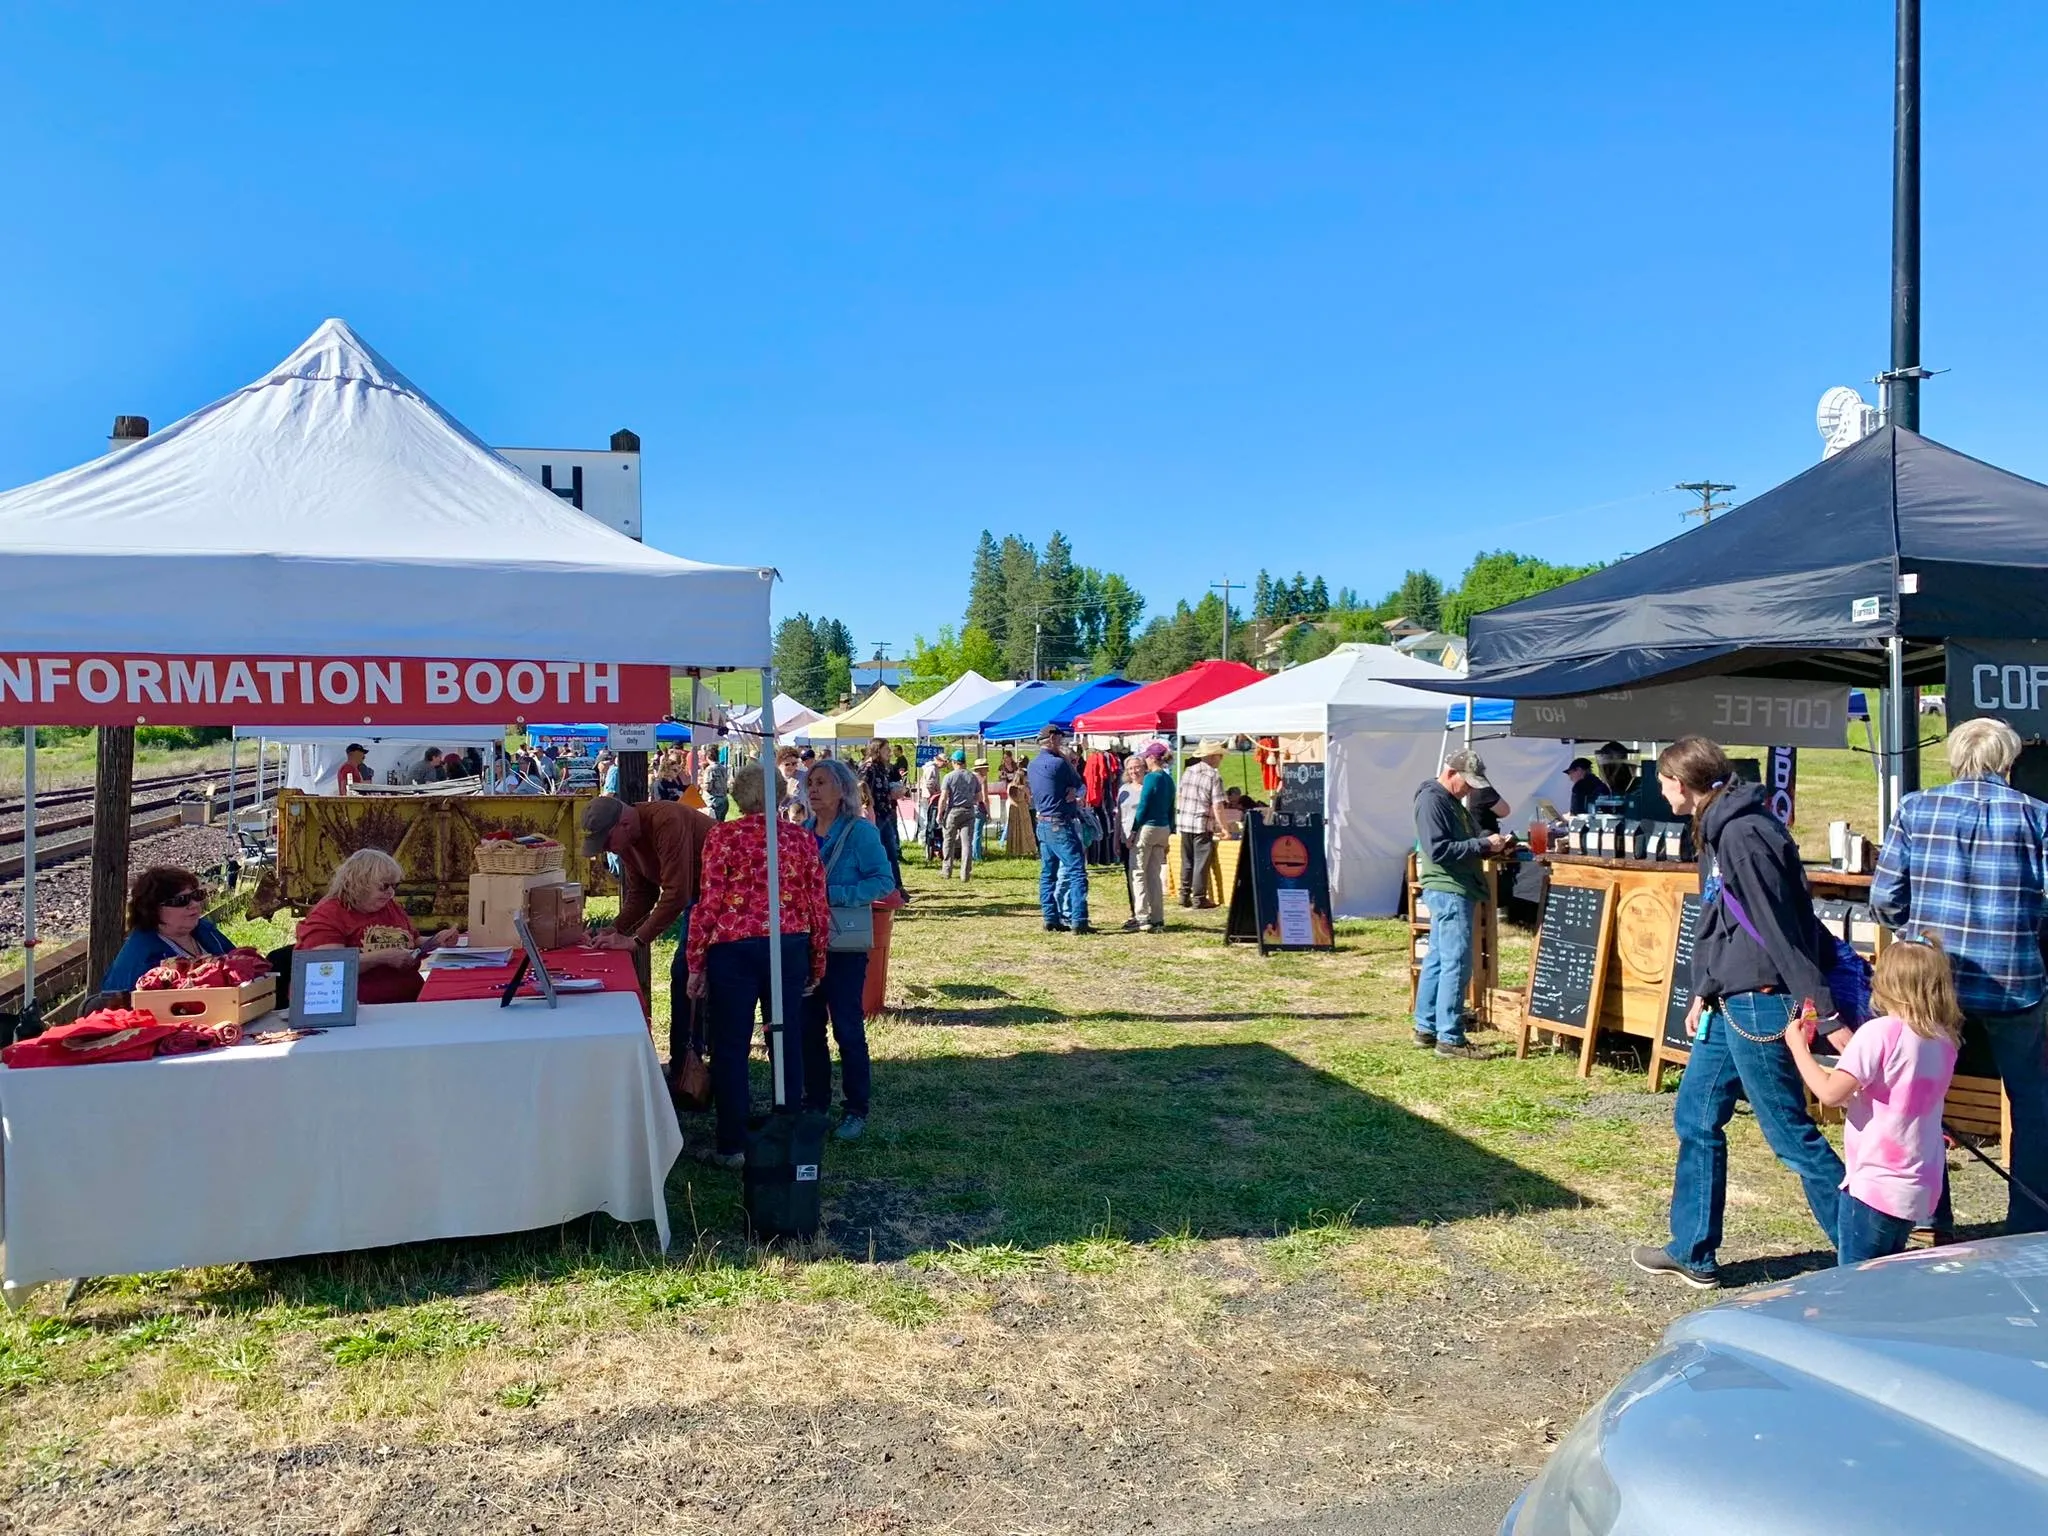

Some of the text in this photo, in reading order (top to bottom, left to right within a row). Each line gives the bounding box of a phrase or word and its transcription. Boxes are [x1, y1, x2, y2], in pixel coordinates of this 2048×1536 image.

[425, 661, 620, 704] BOOTH
[1972, 664, 2048, 710] COF
[619, 728, 646, 736] Customers
[626, 737, 639, 745] Only
